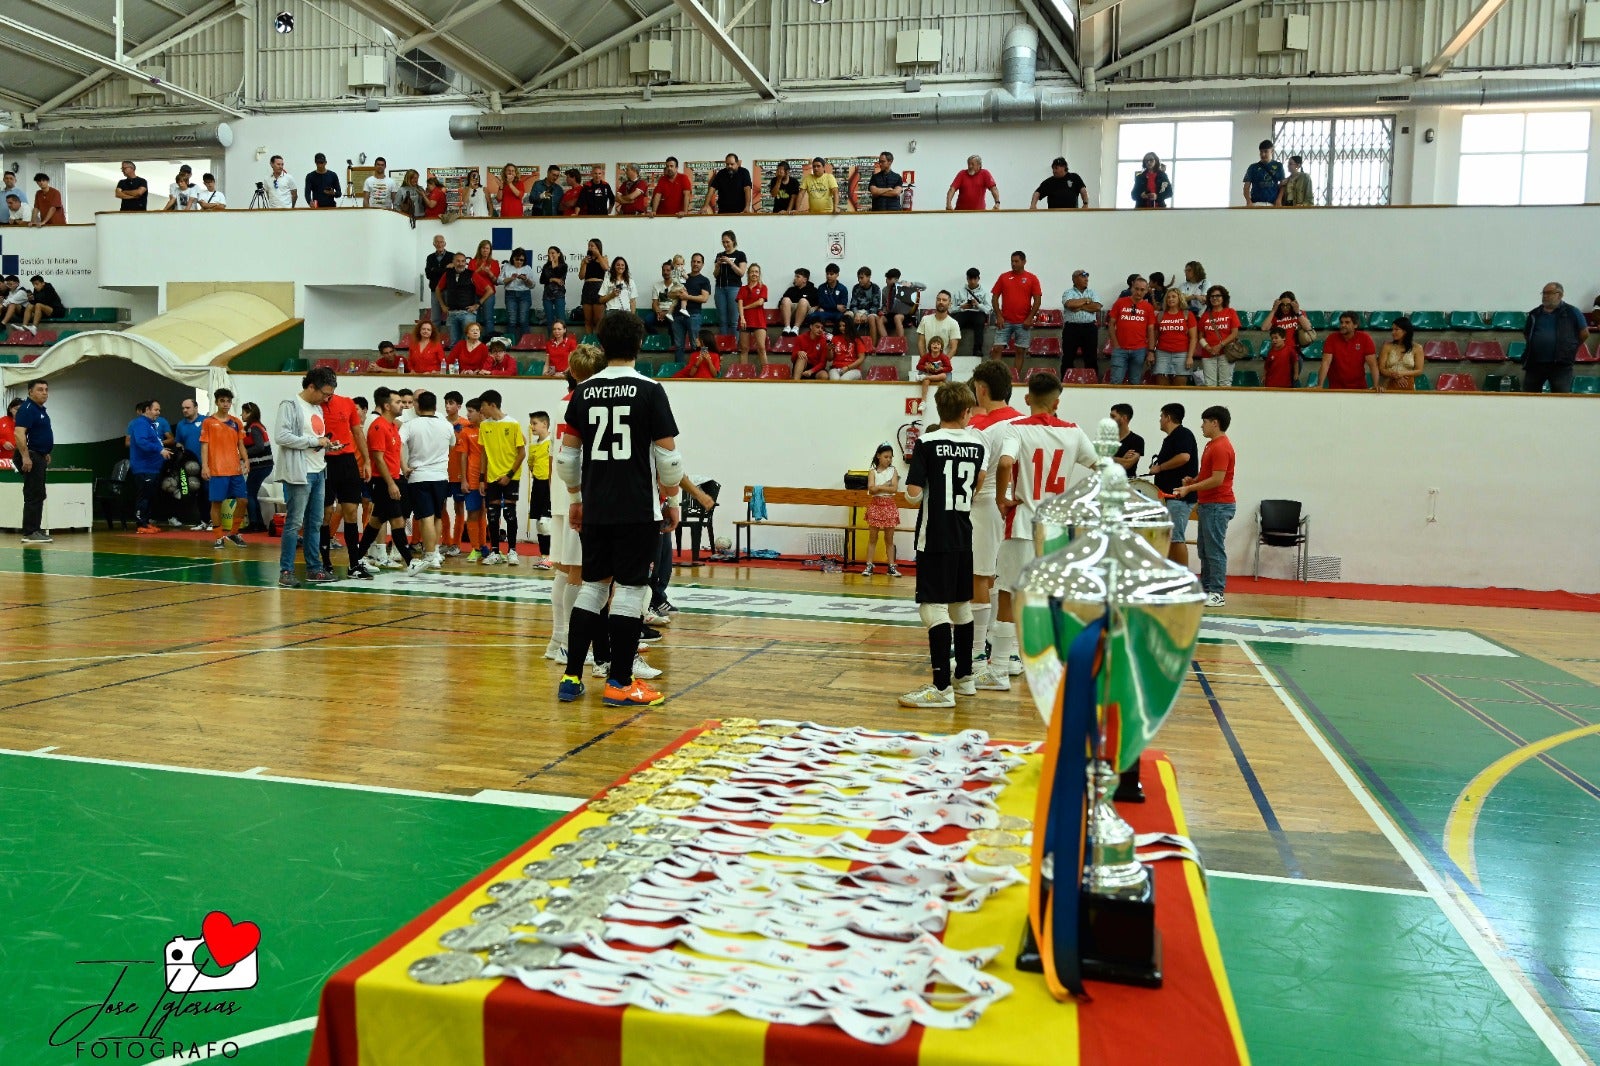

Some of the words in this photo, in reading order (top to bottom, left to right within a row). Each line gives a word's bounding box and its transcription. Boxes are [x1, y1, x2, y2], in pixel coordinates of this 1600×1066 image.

[583, 384, 637, 400] CAYETANO
[588, 405, 632, 461] 25
[936, 444, 979, 459] ERLANTZ
[943, 459, 976, 512] 13
[1032, 448, 1066, 500] 14
